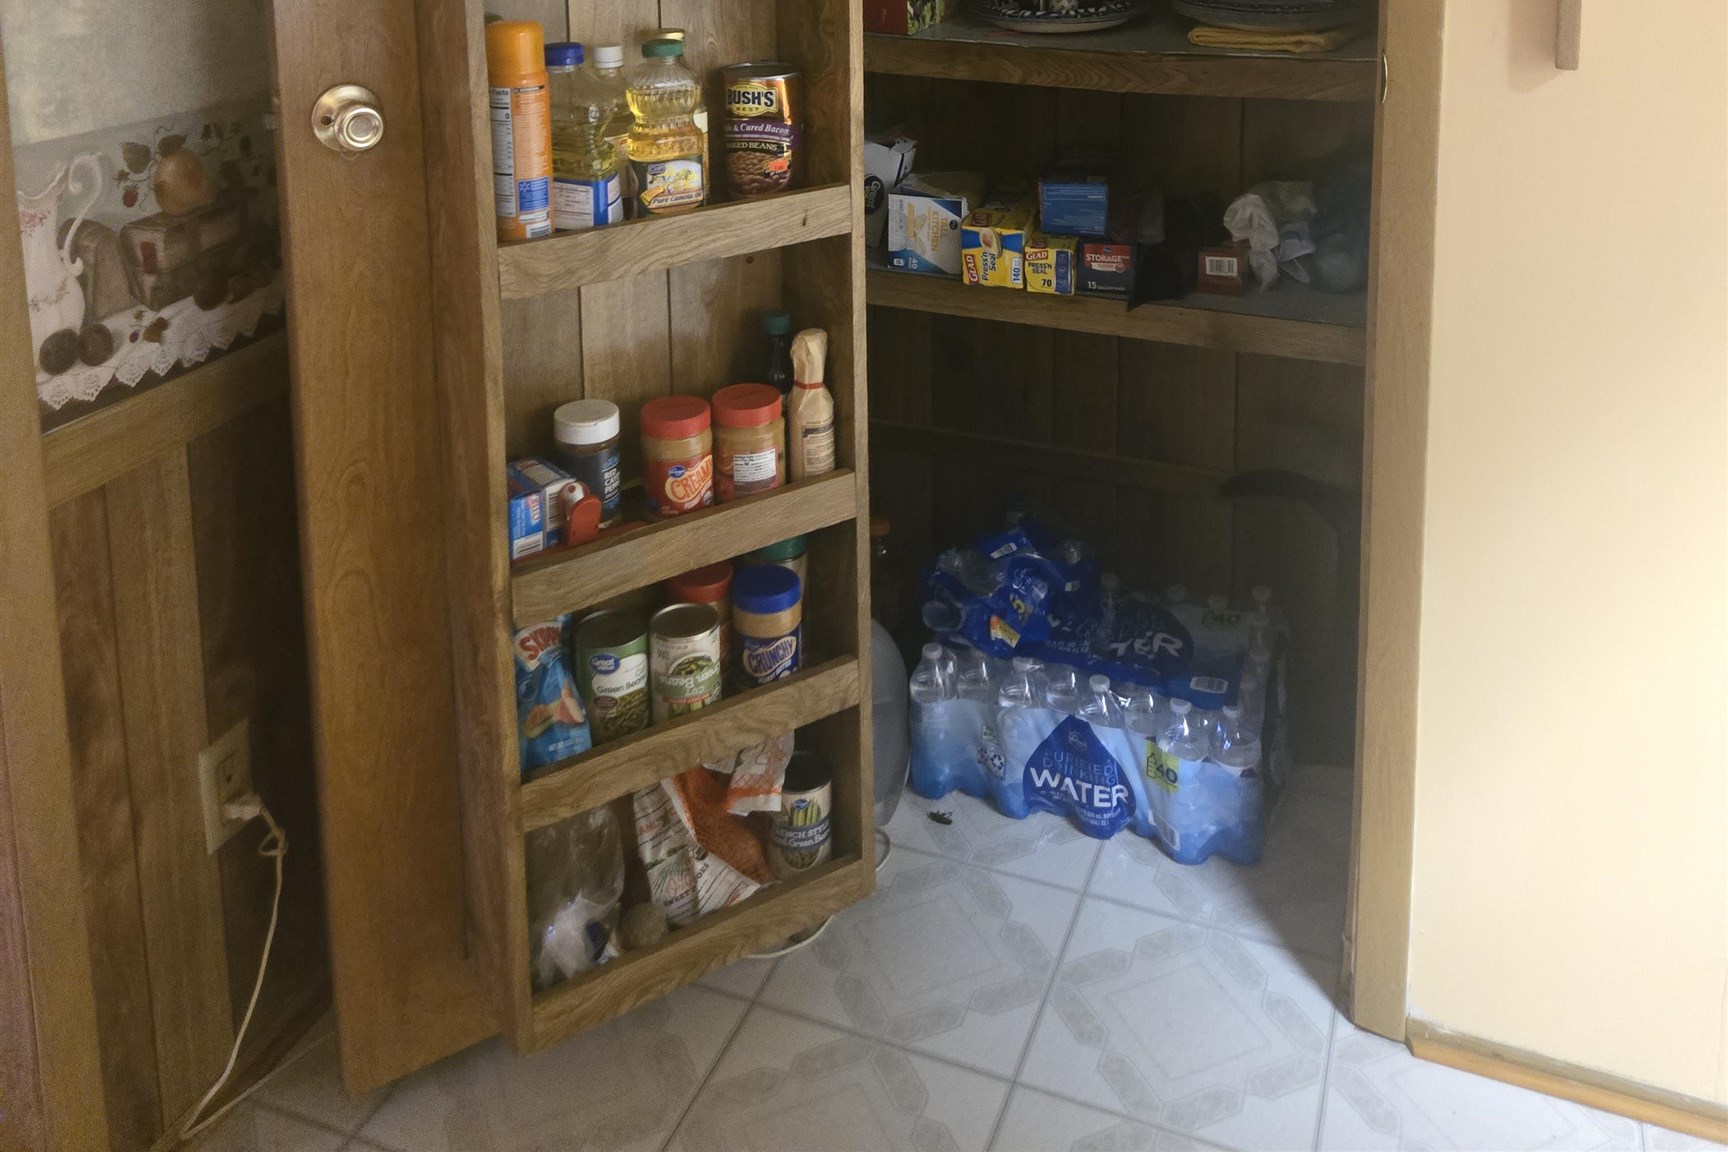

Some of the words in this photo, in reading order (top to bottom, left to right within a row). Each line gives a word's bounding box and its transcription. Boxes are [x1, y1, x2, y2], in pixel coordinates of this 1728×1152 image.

[727, 88, 774, 108] BUSH'S
[740, 123, 763, 132] Cured
[764, 124, 790, 135] Bacon
[749, 142, 778, 151] BEANS
[930, 210, 940, 252] KITCHEN
[988, 253, 997, 272] Seal
[1026, 251, 1048, 261] GLAD
[1086, 253, 1122, 263] STORAGE
[965, 255, 979, 283] GLAD
[1042, 278, 1052, 287] 70
[1087, 280, 1097, 290] 15
[670, 457, 713, 501] CREAM
[747, 638, 793, 673] CRUNCHY
[597, 684, 625, 695] Green
[1029, 767, 1129, 808] WATER
